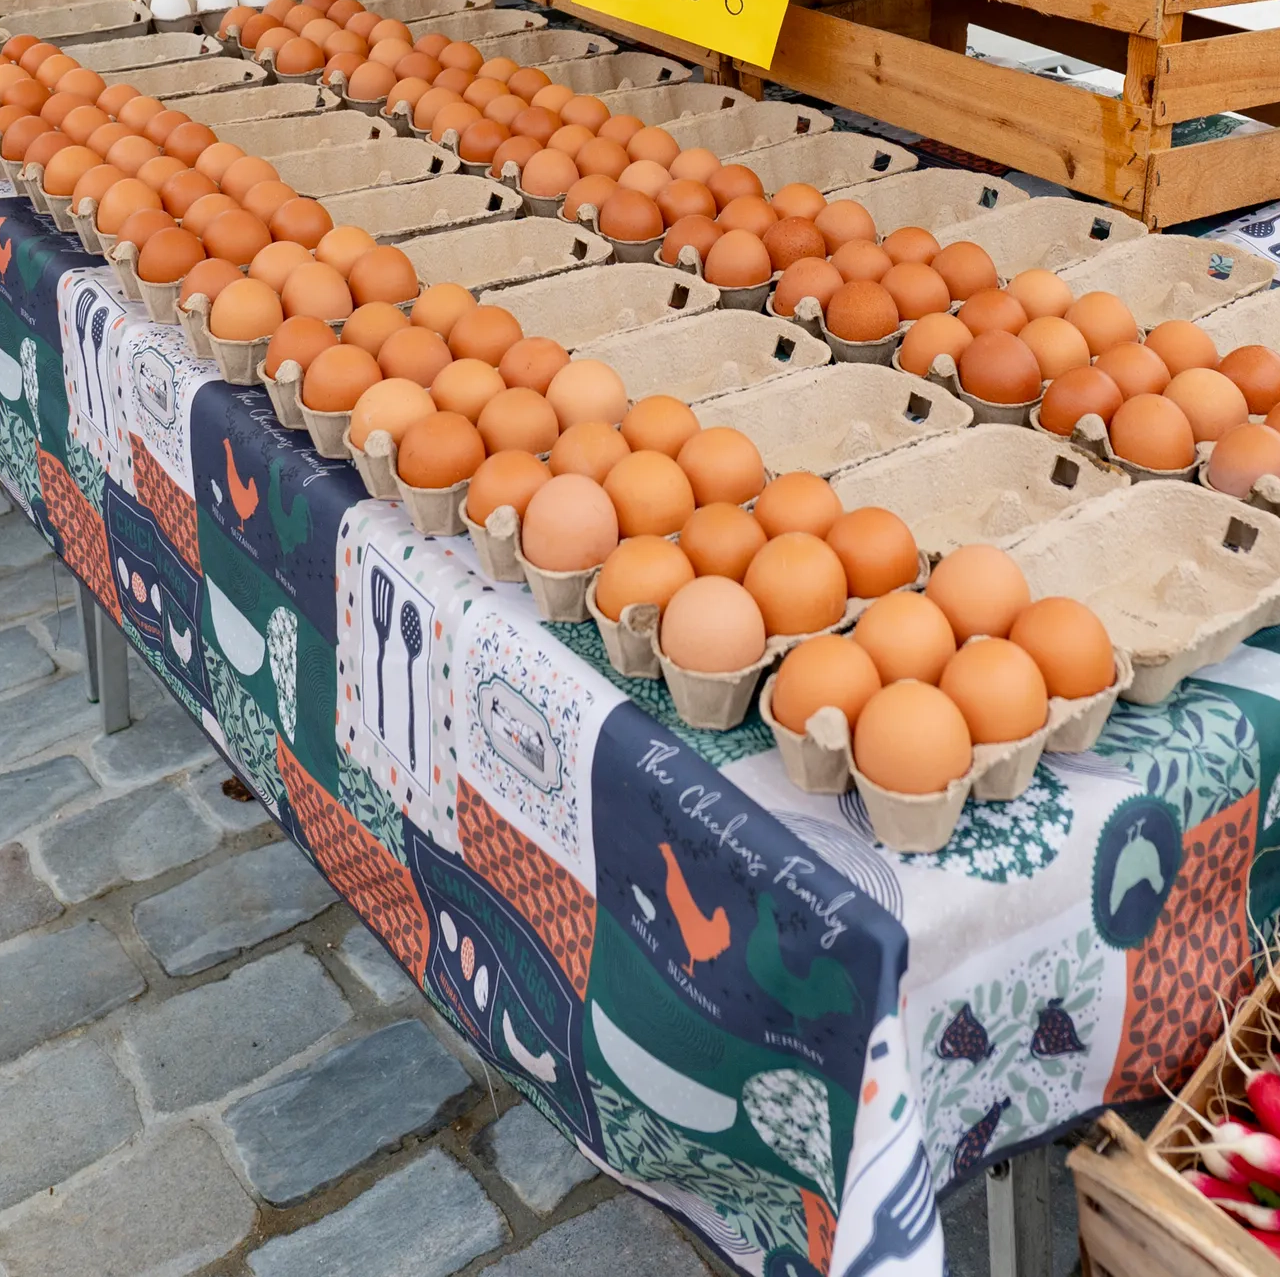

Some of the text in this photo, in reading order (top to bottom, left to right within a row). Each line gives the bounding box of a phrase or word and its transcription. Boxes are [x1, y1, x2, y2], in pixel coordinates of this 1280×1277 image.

[636, 738, 857, 951] The Chickens Family
[431, 864, 558, 1026] CHICKEN EGGS
[629, 914, 826, 1066] MILLY SUZANNE JEREMY
